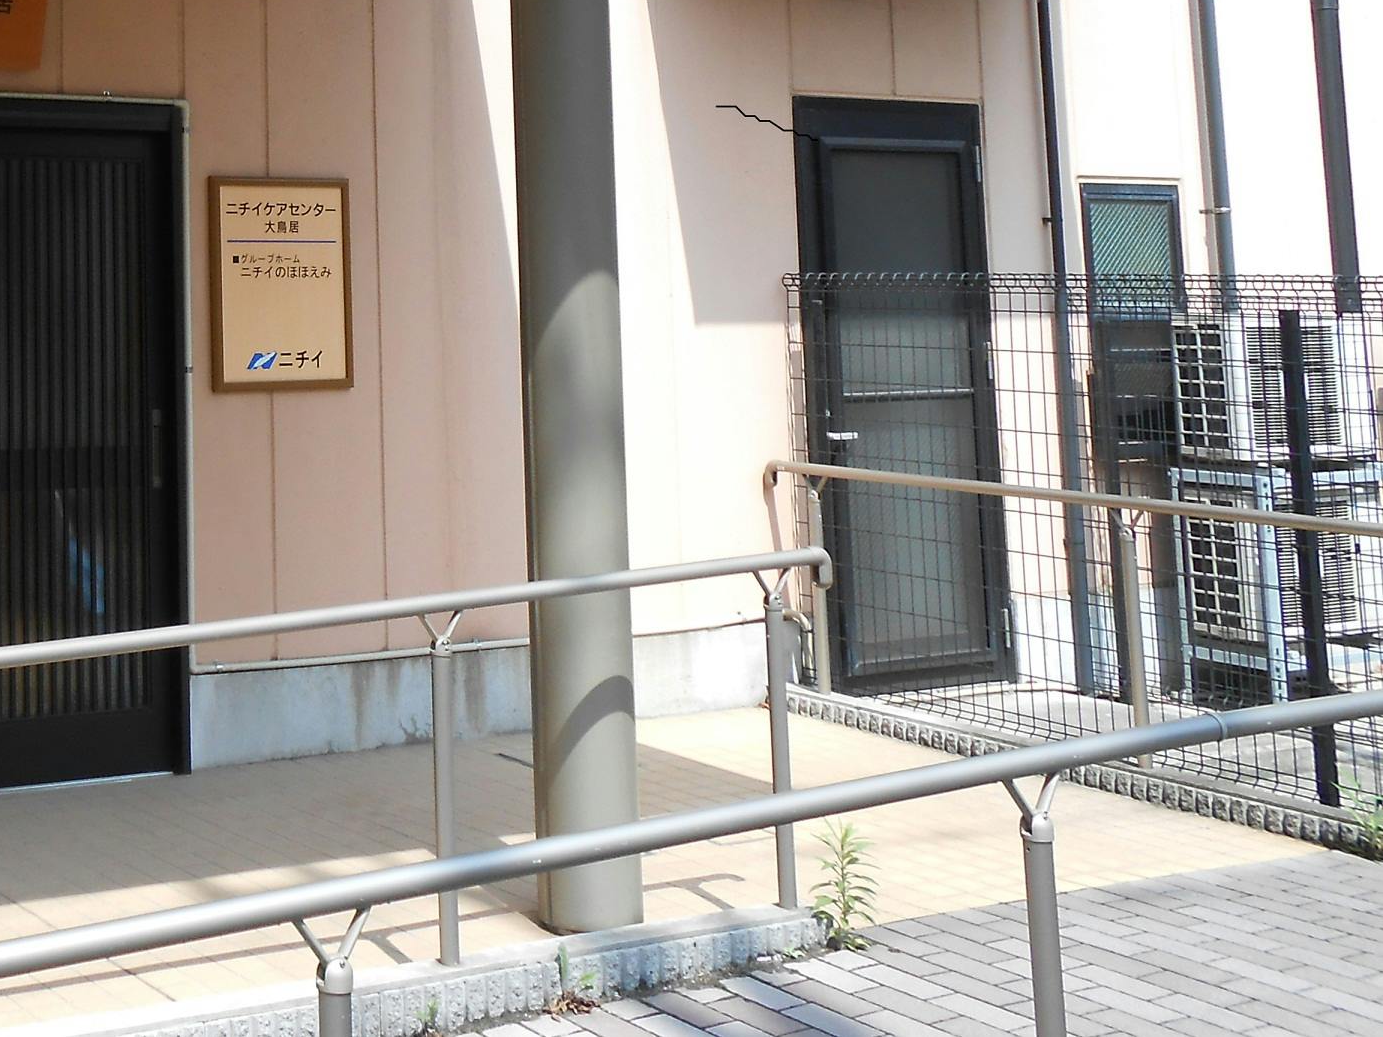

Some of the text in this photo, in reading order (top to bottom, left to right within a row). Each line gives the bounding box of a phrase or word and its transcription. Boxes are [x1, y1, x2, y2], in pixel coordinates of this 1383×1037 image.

[226, 202, 337, 217] ニチイケアセンター
[265, 221, 300, 234] 大鳥居
[240, 254, 300, 264] グループホーム
[240, 266, 332, 279] ニチイのほほえみ
[278, 350, 323, 369] ニチイ
